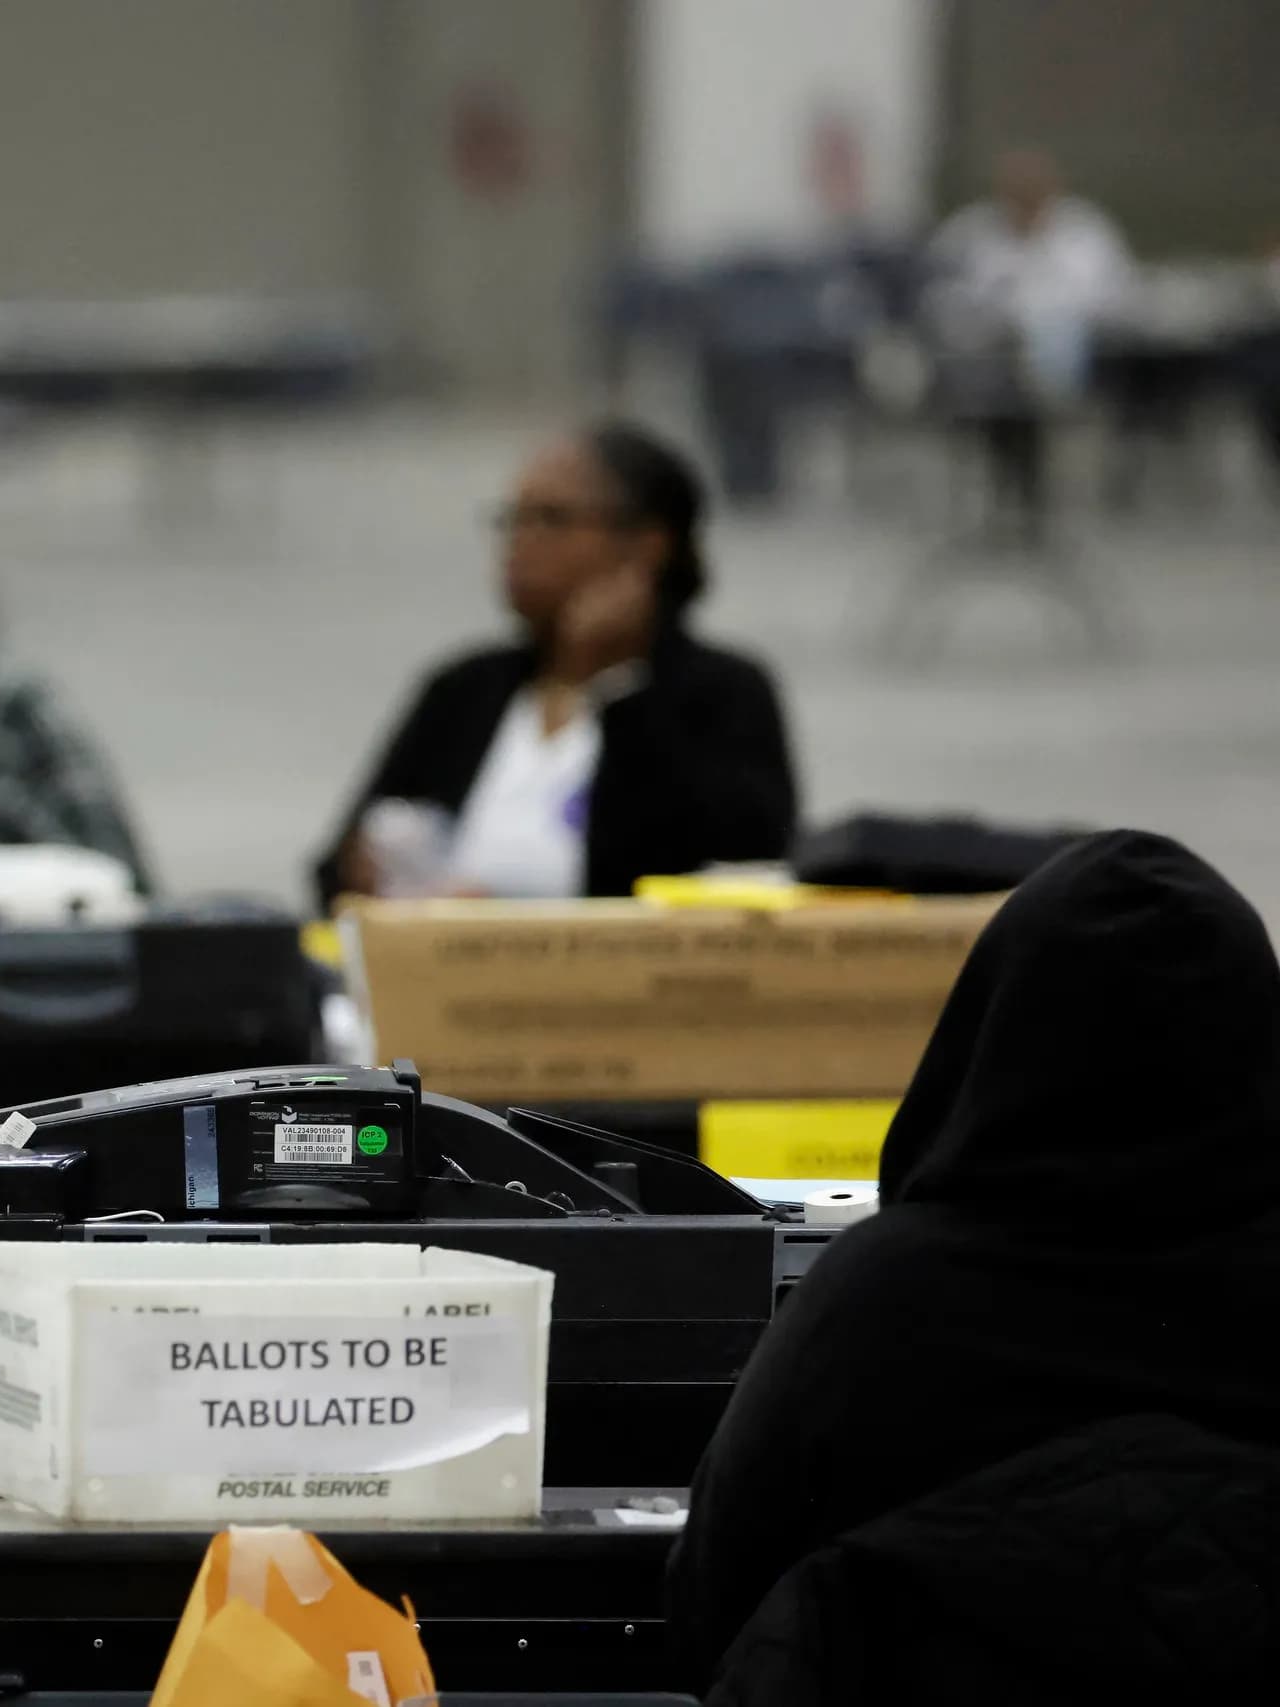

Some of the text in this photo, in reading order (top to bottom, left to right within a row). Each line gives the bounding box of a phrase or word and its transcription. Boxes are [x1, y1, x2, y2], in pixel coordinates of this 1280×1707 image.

[171, 1337, 448, 1371] BALLOTS TO BE
[201, 1396, 415, 1428] TABULATED
[217, 1479, 391, 1499] POSTAL SERVICE
